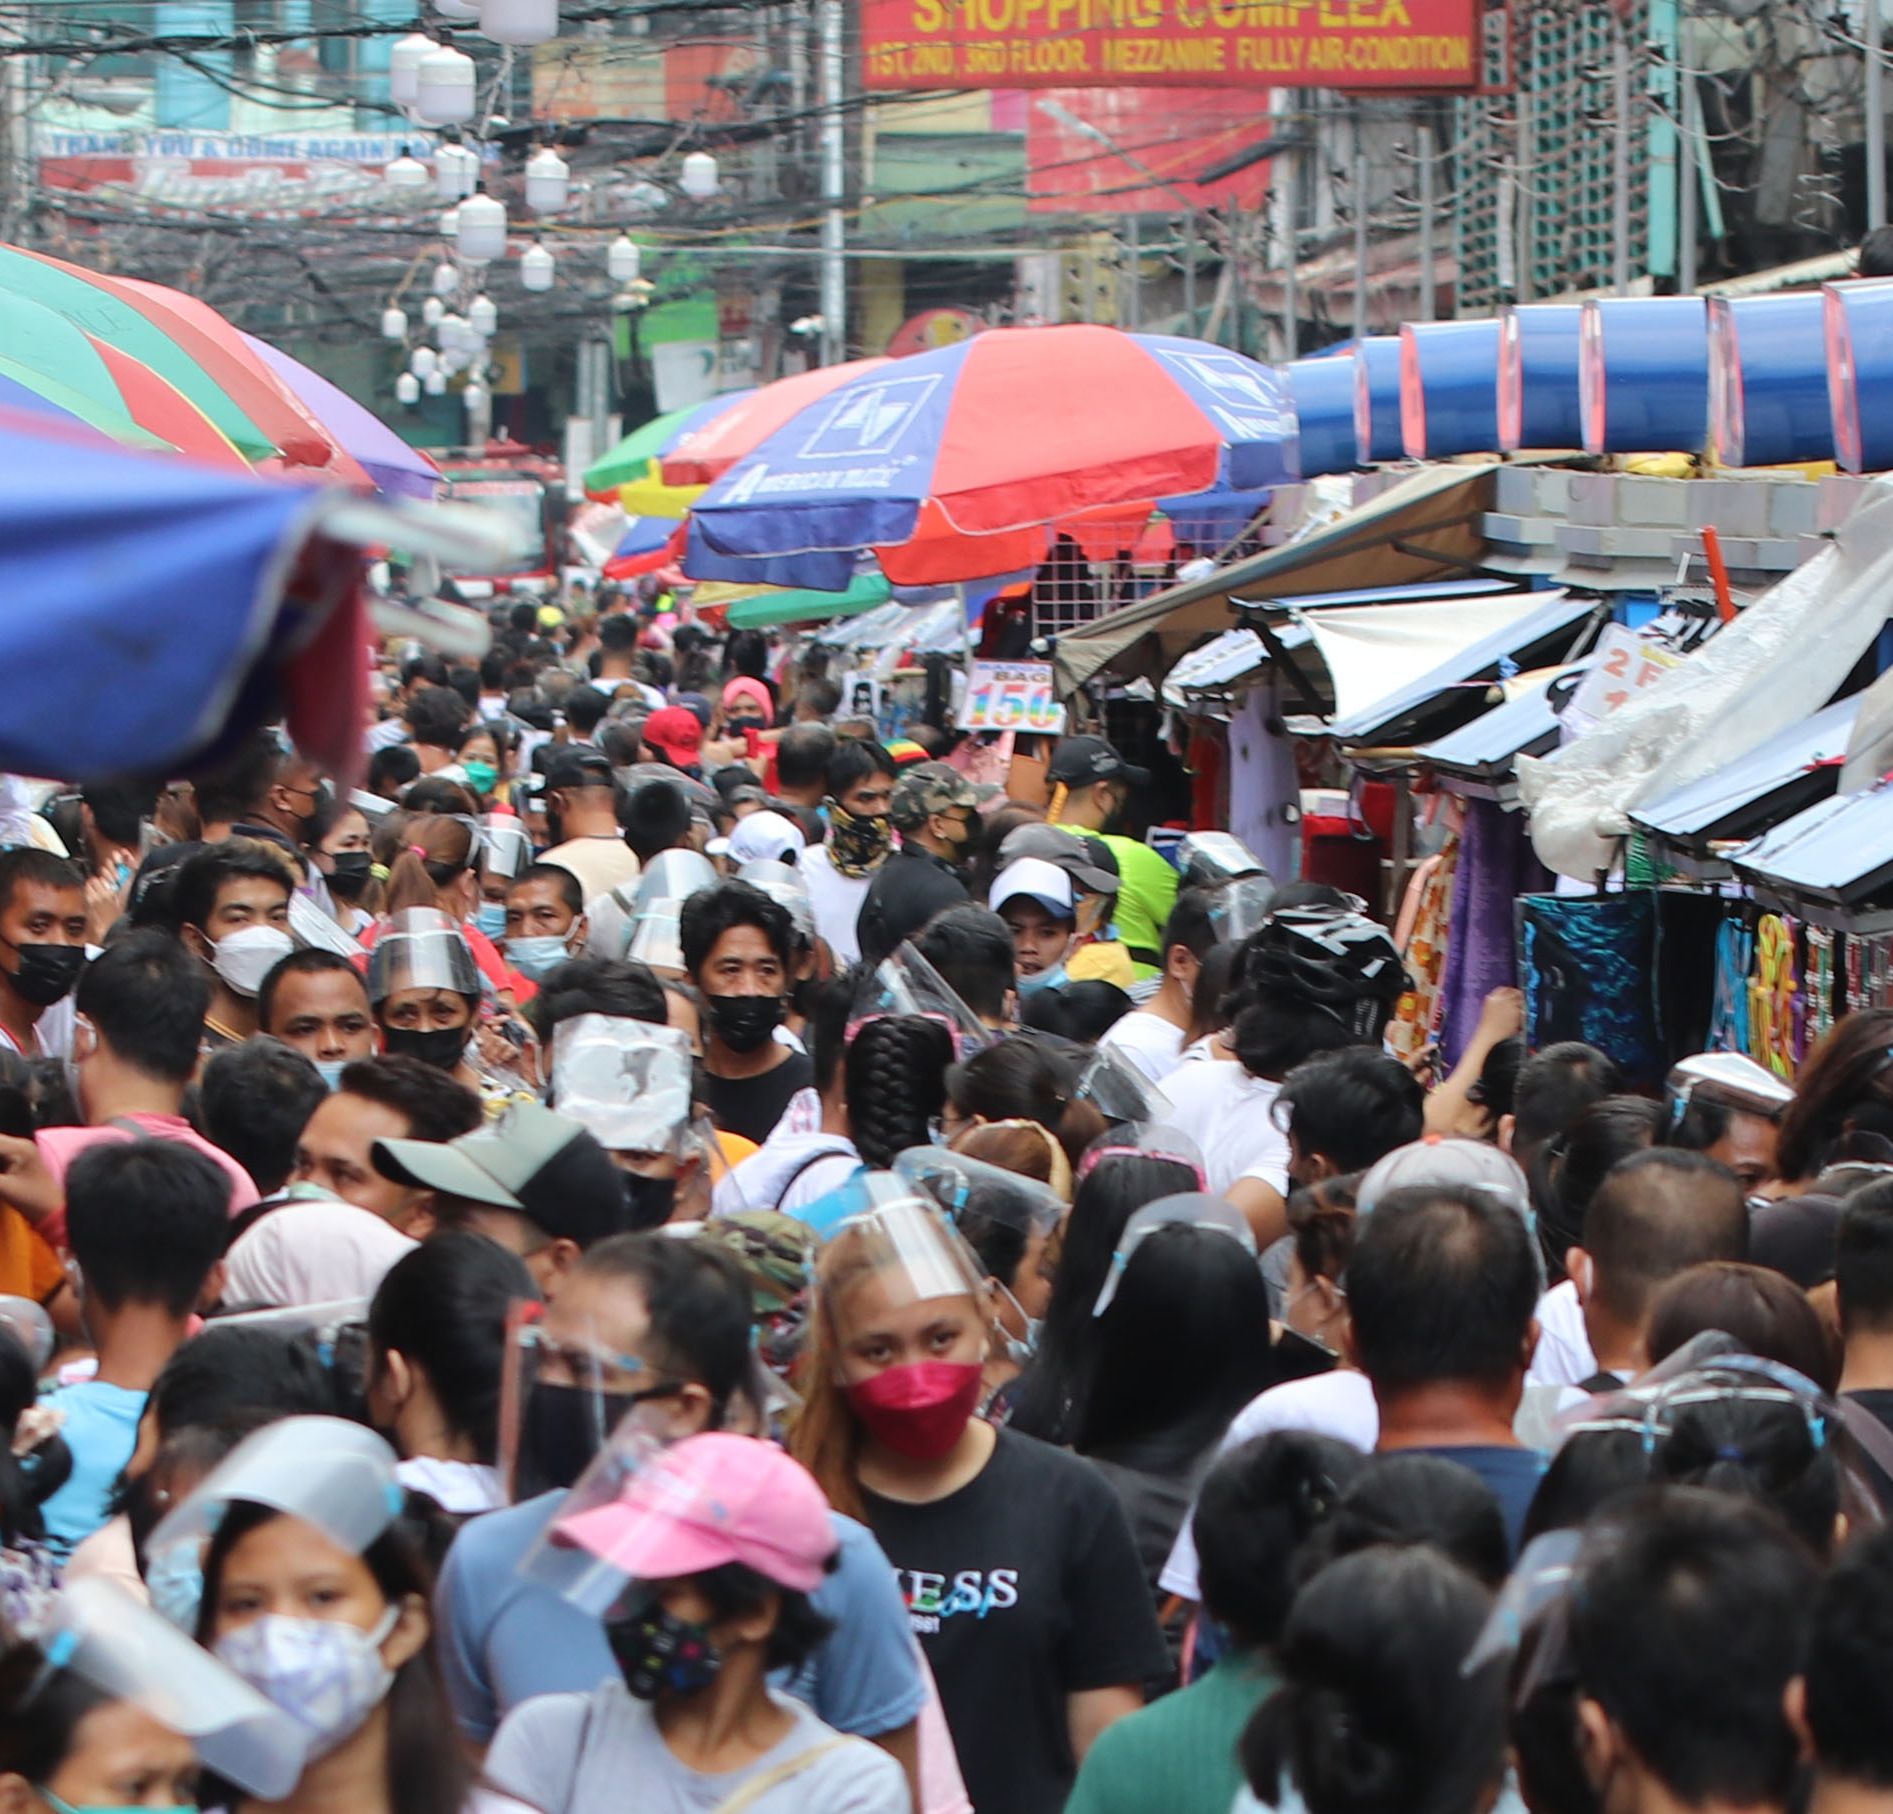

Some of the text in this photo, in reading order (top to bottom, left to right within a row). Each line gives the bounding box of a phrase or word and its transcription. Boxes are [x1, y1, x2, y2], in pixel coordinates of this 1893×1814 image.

[912, 0, 1412, 33] SHOPPING COMPLEX
[1103, 37, 1226, 72] MEZZANINE
[1237, 37, 1303, 71] FULLY
[1309, 36, 1470, 70] AIR-CONDITION
[967, 683, 1059, 728] 150
[894, 1567, 1019, 1613] ESS
